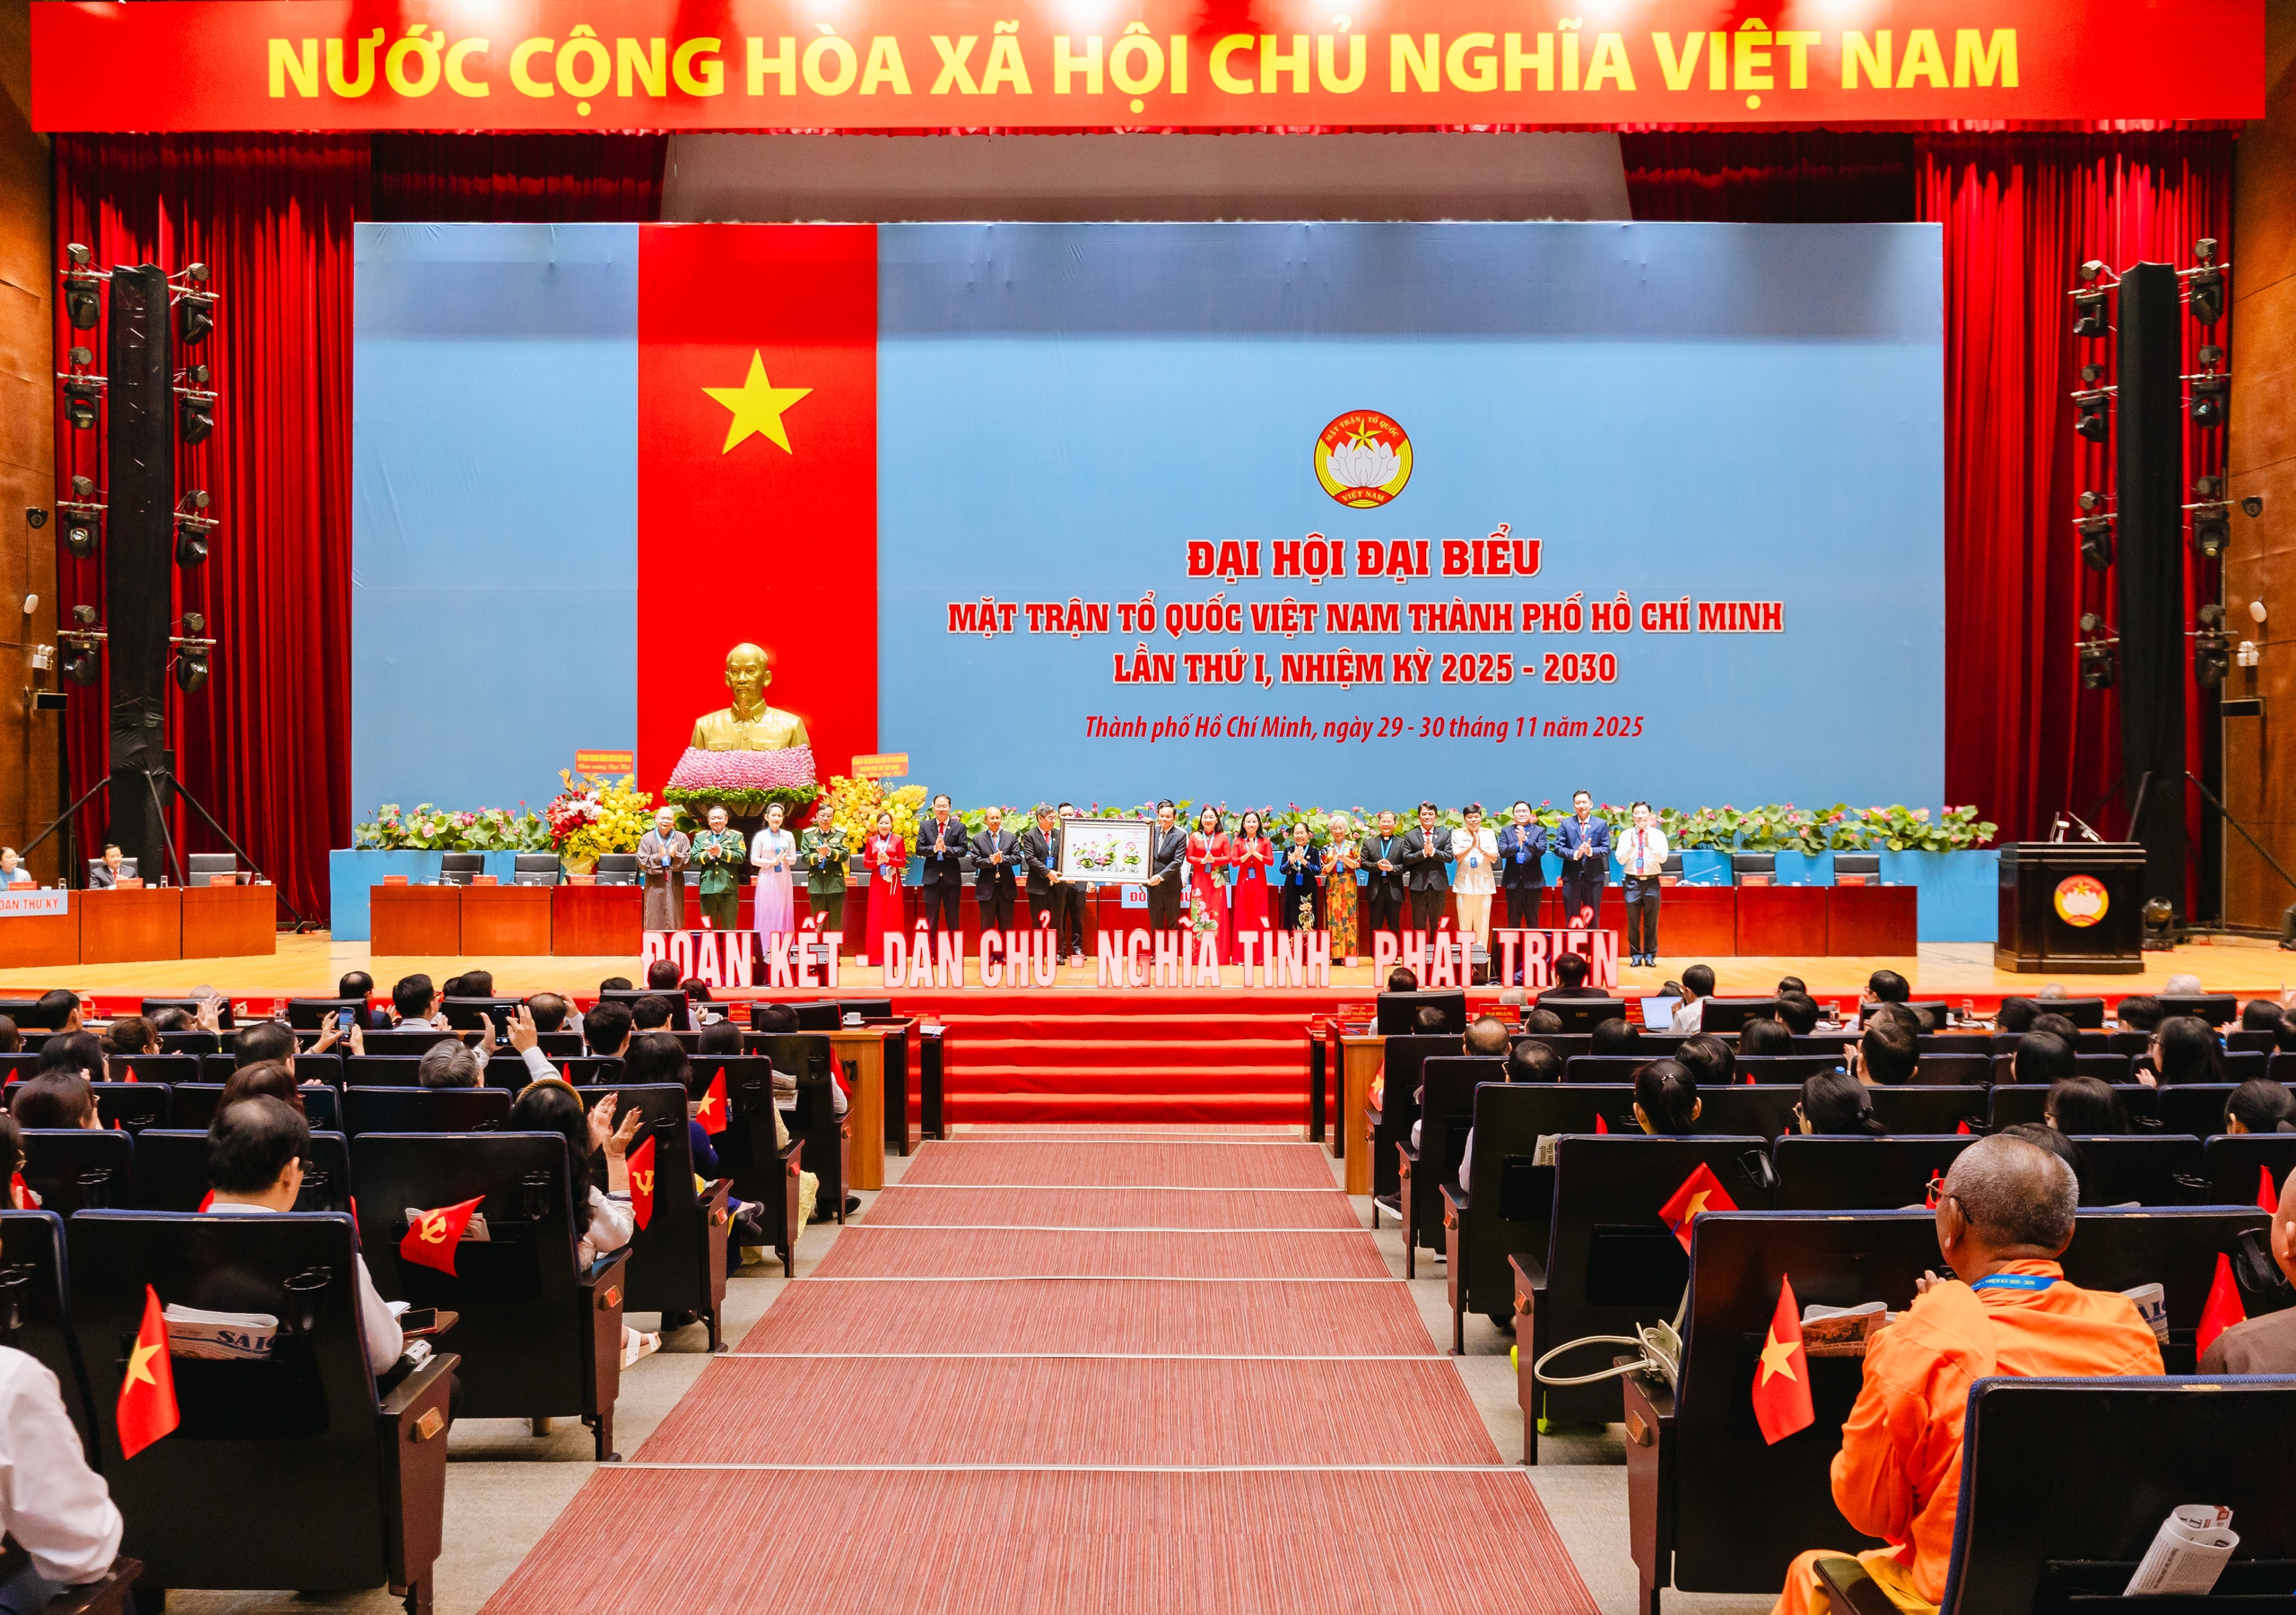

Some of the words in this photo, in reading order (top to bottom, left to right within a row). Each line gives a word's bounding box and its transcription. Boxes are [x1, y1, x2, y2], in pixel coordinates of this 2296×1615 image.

[268, 25, 491, 98] NƯỚC
[509, 23, 725, 117] CỘNG
[746, 22, 912, 97] HÒA
[930, 20, 1033, 95] XÃ
[1053, 22, 1188, 114] HỘI
[1209, 14, 1368, 95] CHỦ
[1389, 17, 1638, 93] NGHĨA
[1650, 17, 1822, 110] VIỆT
[1841, 28, 2021, 90] NAM
[1342, 491, 1363, 502] VIỆT
[1365, 491, 1385, 502] NAM
[1187, 540, 1260, 584] ĐẠI
[1273, 532, 1344, 584] HỘI
[1357, 539, 1430, 583] ĐẠI
[1442, 523, 1541, 576] BIỂU
[948, 598, 1017, 637] MẶT
[1025, 597, 1109, 638] TRẬN
[1118, 591, 1155, 631] TỔ
[1165, 593, 1241, 638] QUỐC
[1250, 597, 1318, 638] VIỆT
[1326, 603, 1399, 631] NAM
[1408, 598, 1513, 631] THÀNH
[1522, 593, 1581, 631] PHỐ
[1591, 592, 1631, 631] HỒ
[1641, 597, 1689, 630] CHÍ
[1699, 603, 1782, 630] MINH
[1114, 648, 1175, 682] LẦN
[1184, 648, 1248, 682] THỨ
[1255, 654, 1272, 688] I,
[1282, 648, 1383, 688] NHIỆM
[1393, 648, 1431, 682] KỲ
[1442, 654, 1512, 682] 2025
[1544, 654, 1615, 682] 2030
[1086, 715, 1146, 738] Thành
[1151, 713, 1195, 743] phố
[1195, 714, 1223, 738] Hồ
[1227, 715, 1257, 738] Chí
[1261, 715, 1318, 742] Minh,
[1323, 716, 1374, 743] ngày
[1377, 716, 1404, 738] 29
[1419, 716, 1446, 738] 30
[1449, 715, 1509, 743] tháng
[1516, 716, 1537, 737] 11
[1543, 716, 1588, 738] năm
[1592, 716, 1645, 737] 2025
[22, 898, 43, 909] THƯ
[641, 916, 753, 988] ĐOÀN
[769, 911, 845, 988] KẾT
[855, 953, 869, 968] -
[883, 917, 964, 988] DÂN
[978, 909, 1058, 988] CHỦ
[1070, 953, 1085, 968] -
[1097, 916, 1222, 988] NGHĨA
[1238, 916, 1331, 988] TÌNH
[1344, 954, 1360, 968] -
[1373, 916, 1477, 988] PHÁT
